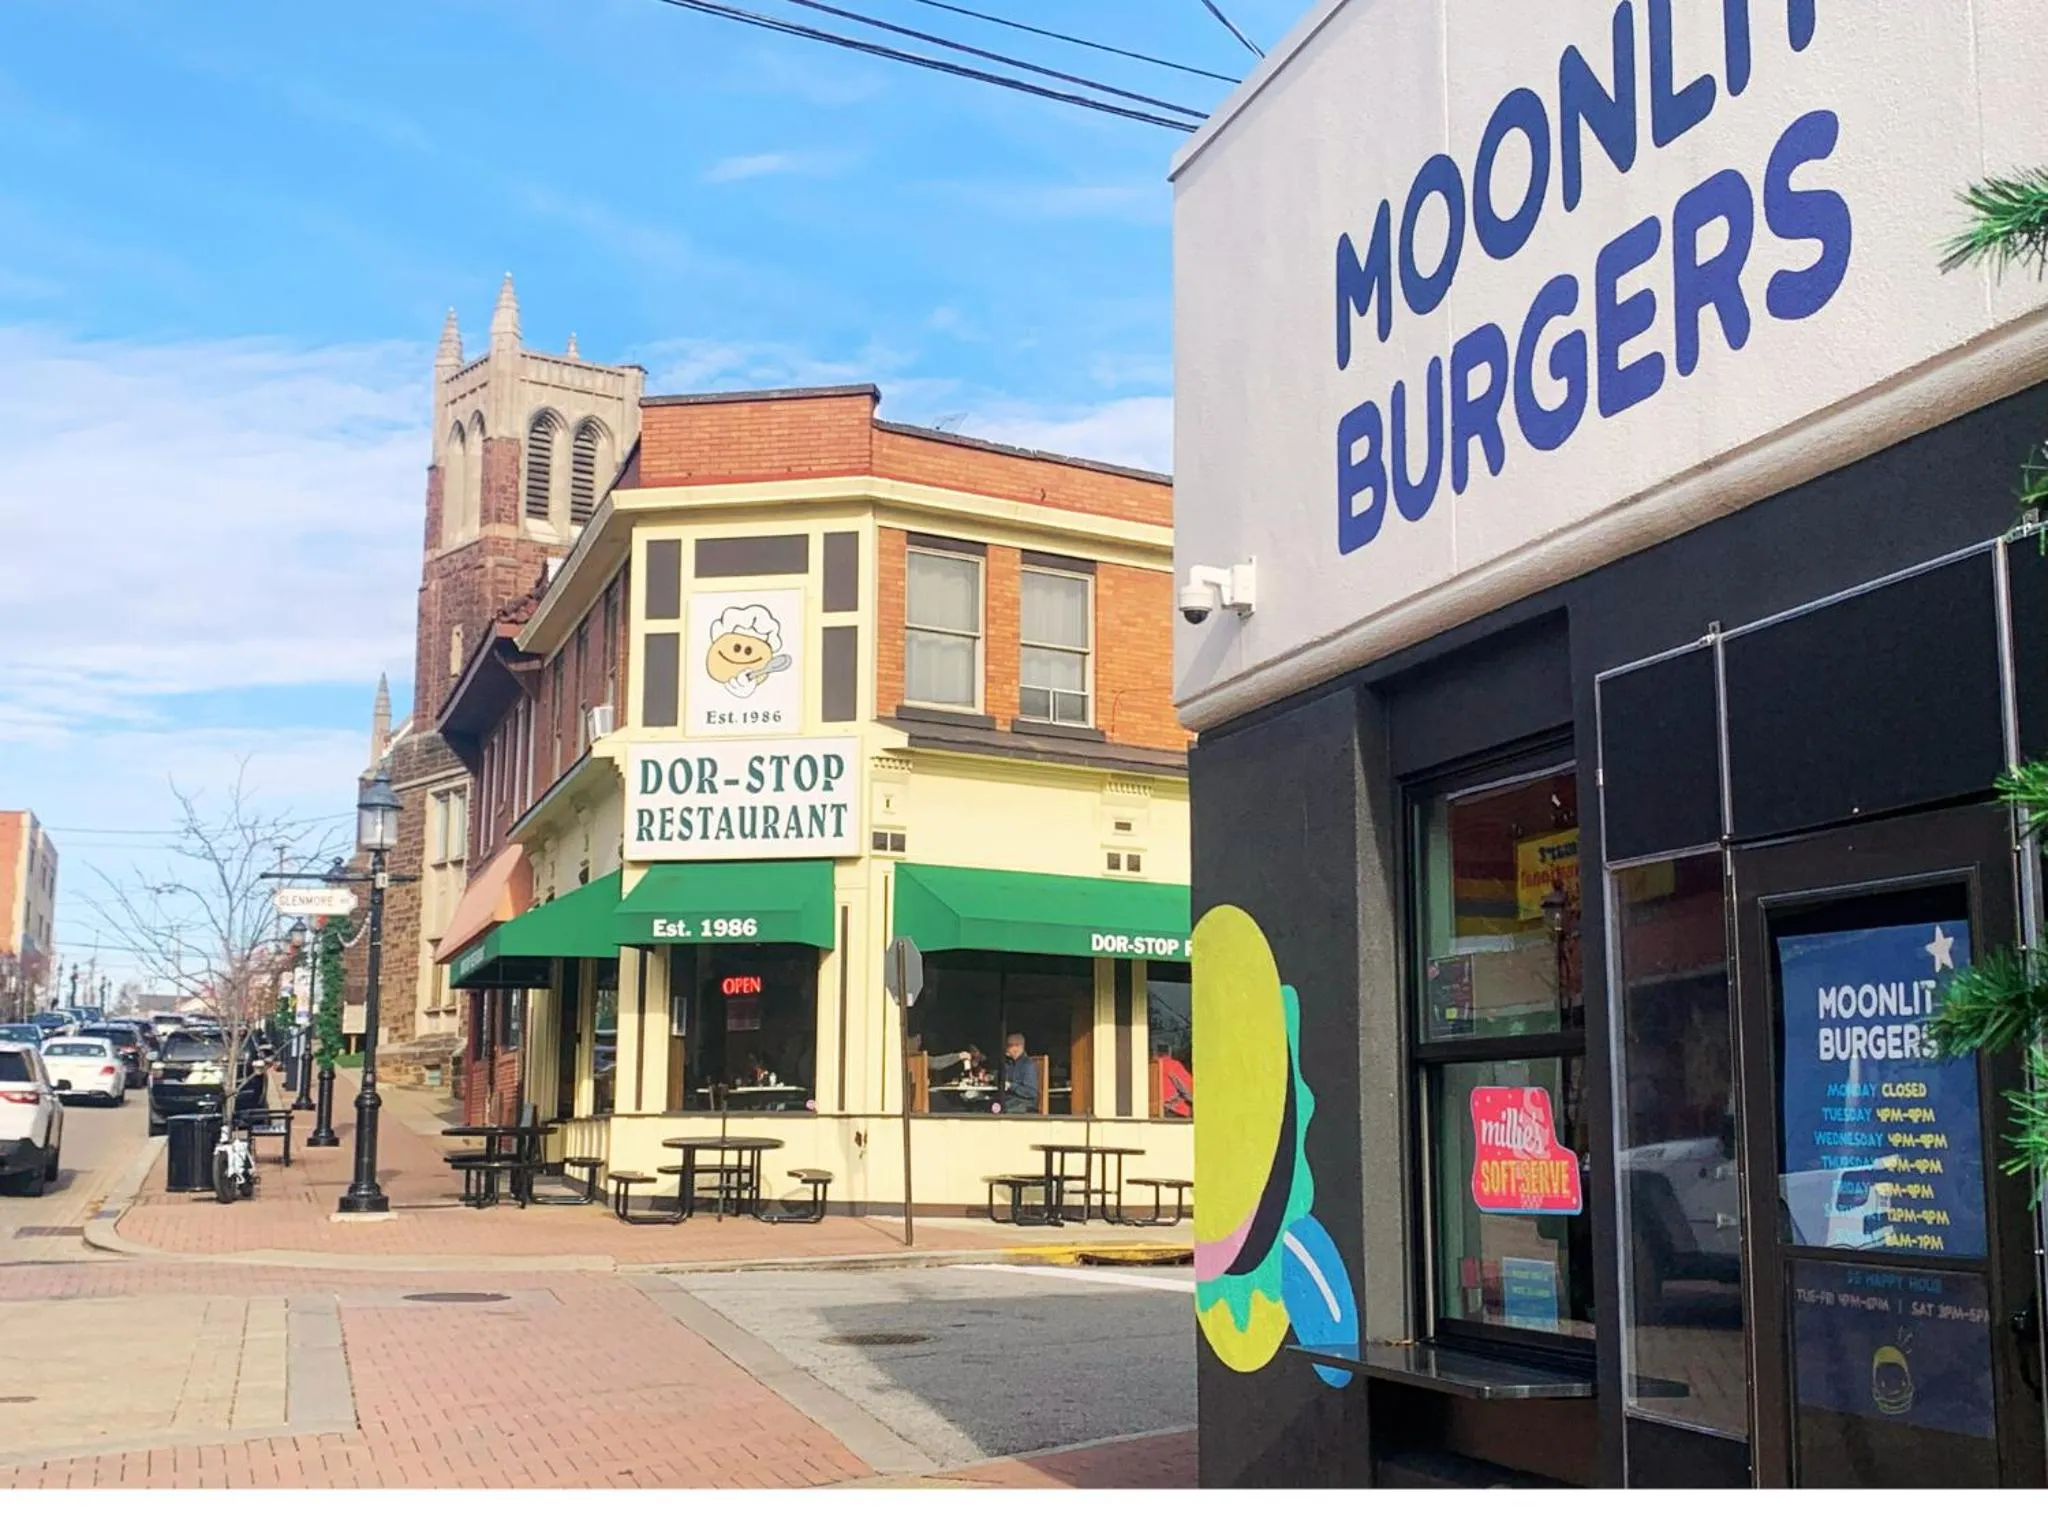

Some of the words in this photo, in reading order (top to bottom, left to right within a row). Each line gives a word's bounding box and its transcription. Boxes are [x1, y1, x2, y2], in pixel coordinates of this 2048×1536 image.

[1337, 109, 1852, 556] BURGERS
[706, 711, 738, 724] Est.
[742, 710, 782, 723] 1986
[639, 754, 844, 794] DOR-STOP
[636, 804, 847, 841] RESTAURANT
[279, 895, 333, 906] GLENMORE
[653, 919, 692, 937] Est.
[701, 918, 757, 937] 1986
[1091, 933, 1180, 956] DOR-STOP
[722, 976, 761, 994] OPEN
[1819, 980, 1936, 1019] MOONLIT
[1881, 1083, 1927, 1098] CLOSED
[1822, 1107, 1872, 1122] TUESDAY
[1814, 1131, 1883, 1148] WEDNESDAY
[1481, 1160, 1516, 1197] SOFT
[1520, 1160, 1571, 1199] SERVE
[1912, 1301, 1933, 1317] SAT
